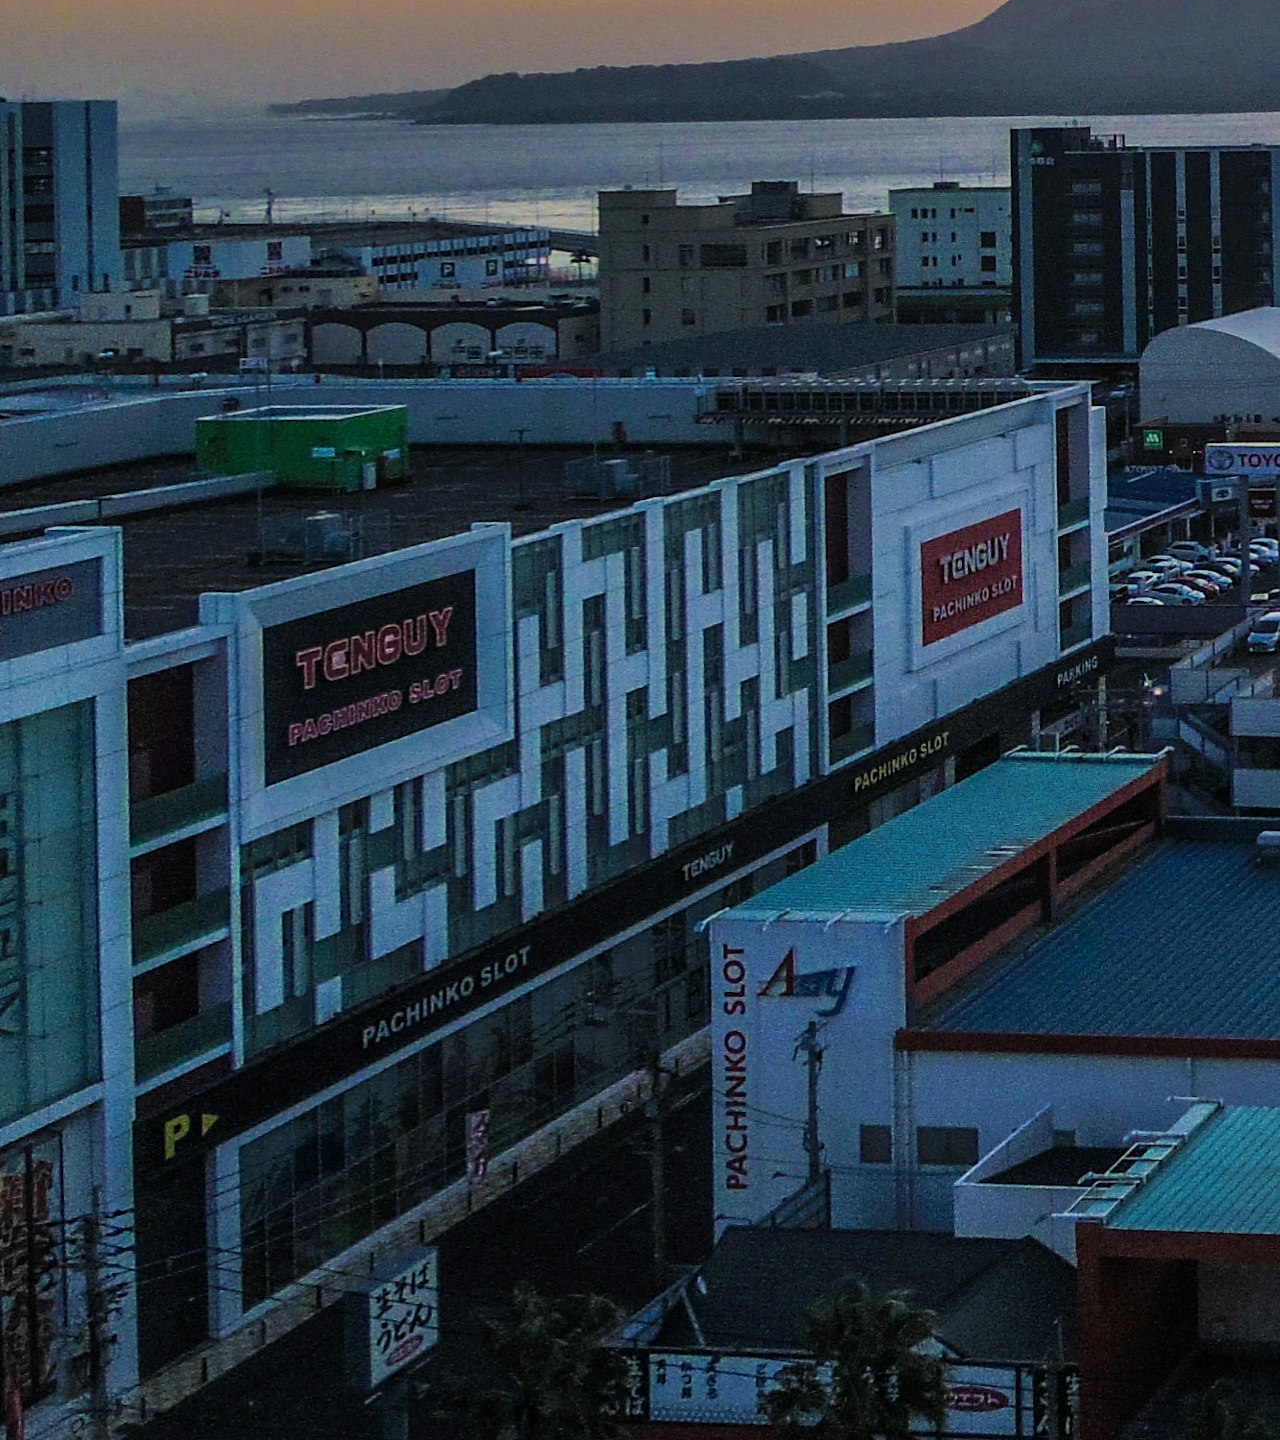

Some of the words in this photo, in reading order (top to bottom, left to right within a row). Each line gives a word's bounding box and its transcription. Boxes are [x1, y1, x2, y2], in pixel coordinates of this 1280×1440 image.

[940, 533, 1010, 583] TENGUY
[933, 588, 990, 623] PACHINKO
[991, 574, 1018, 606] SLOT
[296, 606, 454, 690] TENGUY
[1057, 655, 1098, 689] PARKING
[289, 690, 402, 746] PACHINKO
[408, 668, 464, 704] SLOT
[854, 747, 917, 794] PACHINKO
[918, 731, 950, 766] SLOT
[681, 841, 734, 882] TENGUY
[362, 973, 476, 1049] PACHINKO
[480, 945, 532, 992] SLOT
[723, 944, 746, 1015] SLOT
[164, 1114, 191, 1160] P
[724, 1028, 748, 1191] PACHINKO
[376, 1262, 430, 1318] 生そば
[377, 1303, 432, 1354] うどん
